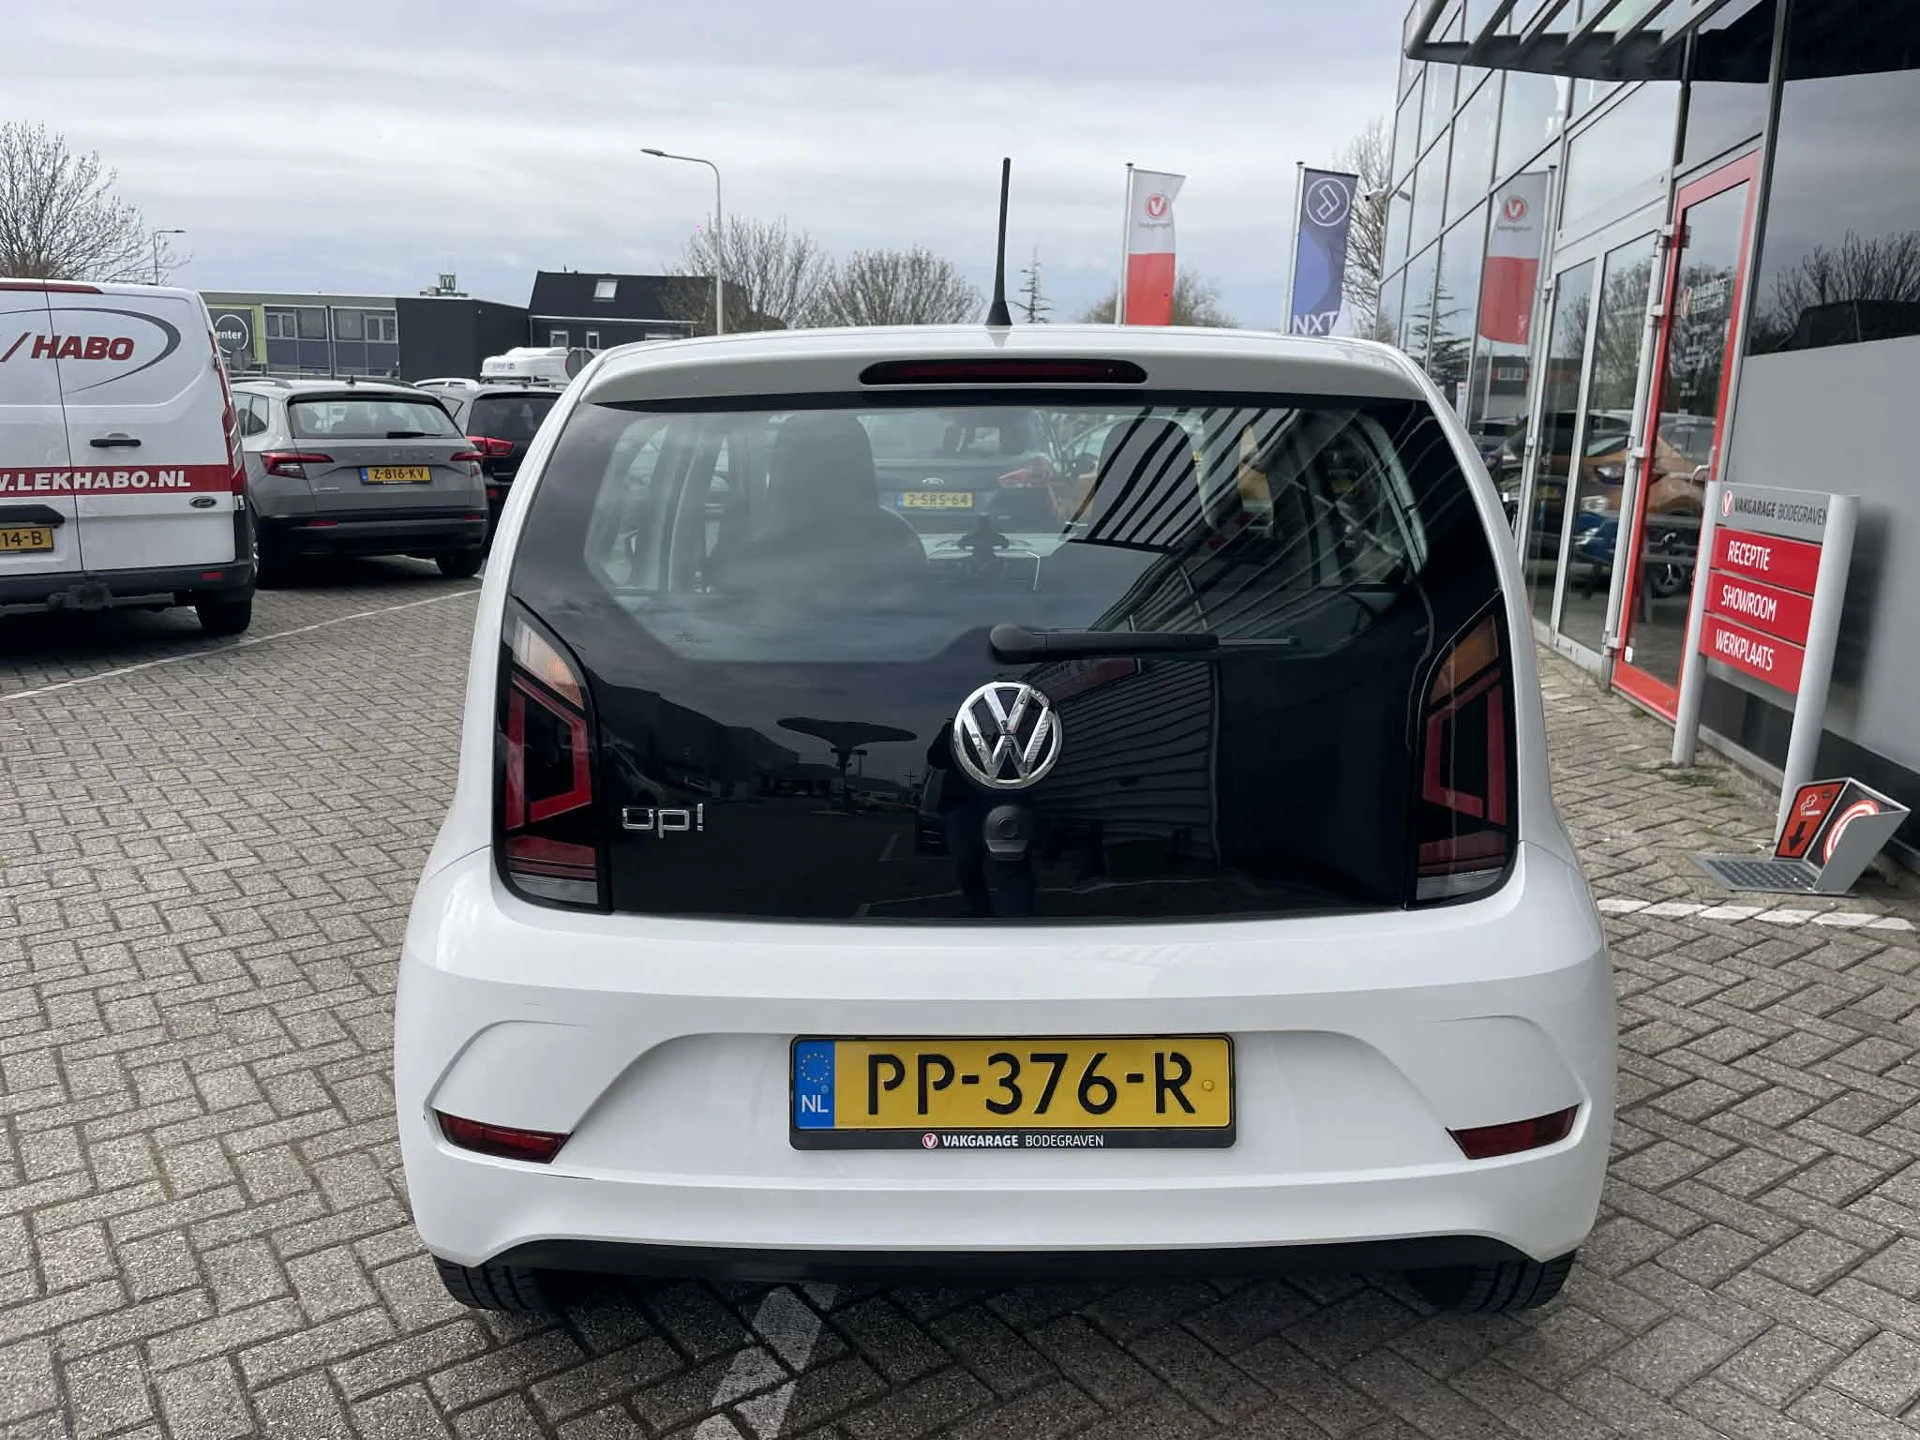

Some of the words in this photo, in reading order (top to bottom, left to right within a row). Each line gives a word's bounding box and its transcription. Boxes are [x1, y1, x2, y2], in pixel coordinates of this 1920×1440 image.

[1292, 310, 1338, 336] NXT
[1734, 496, 1777, 518] VAKGARAGE
[1727, 540, 1771, 570] RECEPTIE
[1721, 584, 1777, 623] SHOWROOM
[1715, 628, 1774, 672] WERKPLAATS
[622, 803, 704, 839] up!
[801, 1094, 829, 1113] NL
[868, 1052, 1196, 1115] PP-376-R
[942, 1134, 1019, 1147] VAKGARAGE
[1025, 1134, 1104, 1147] BODEGRAVEN
